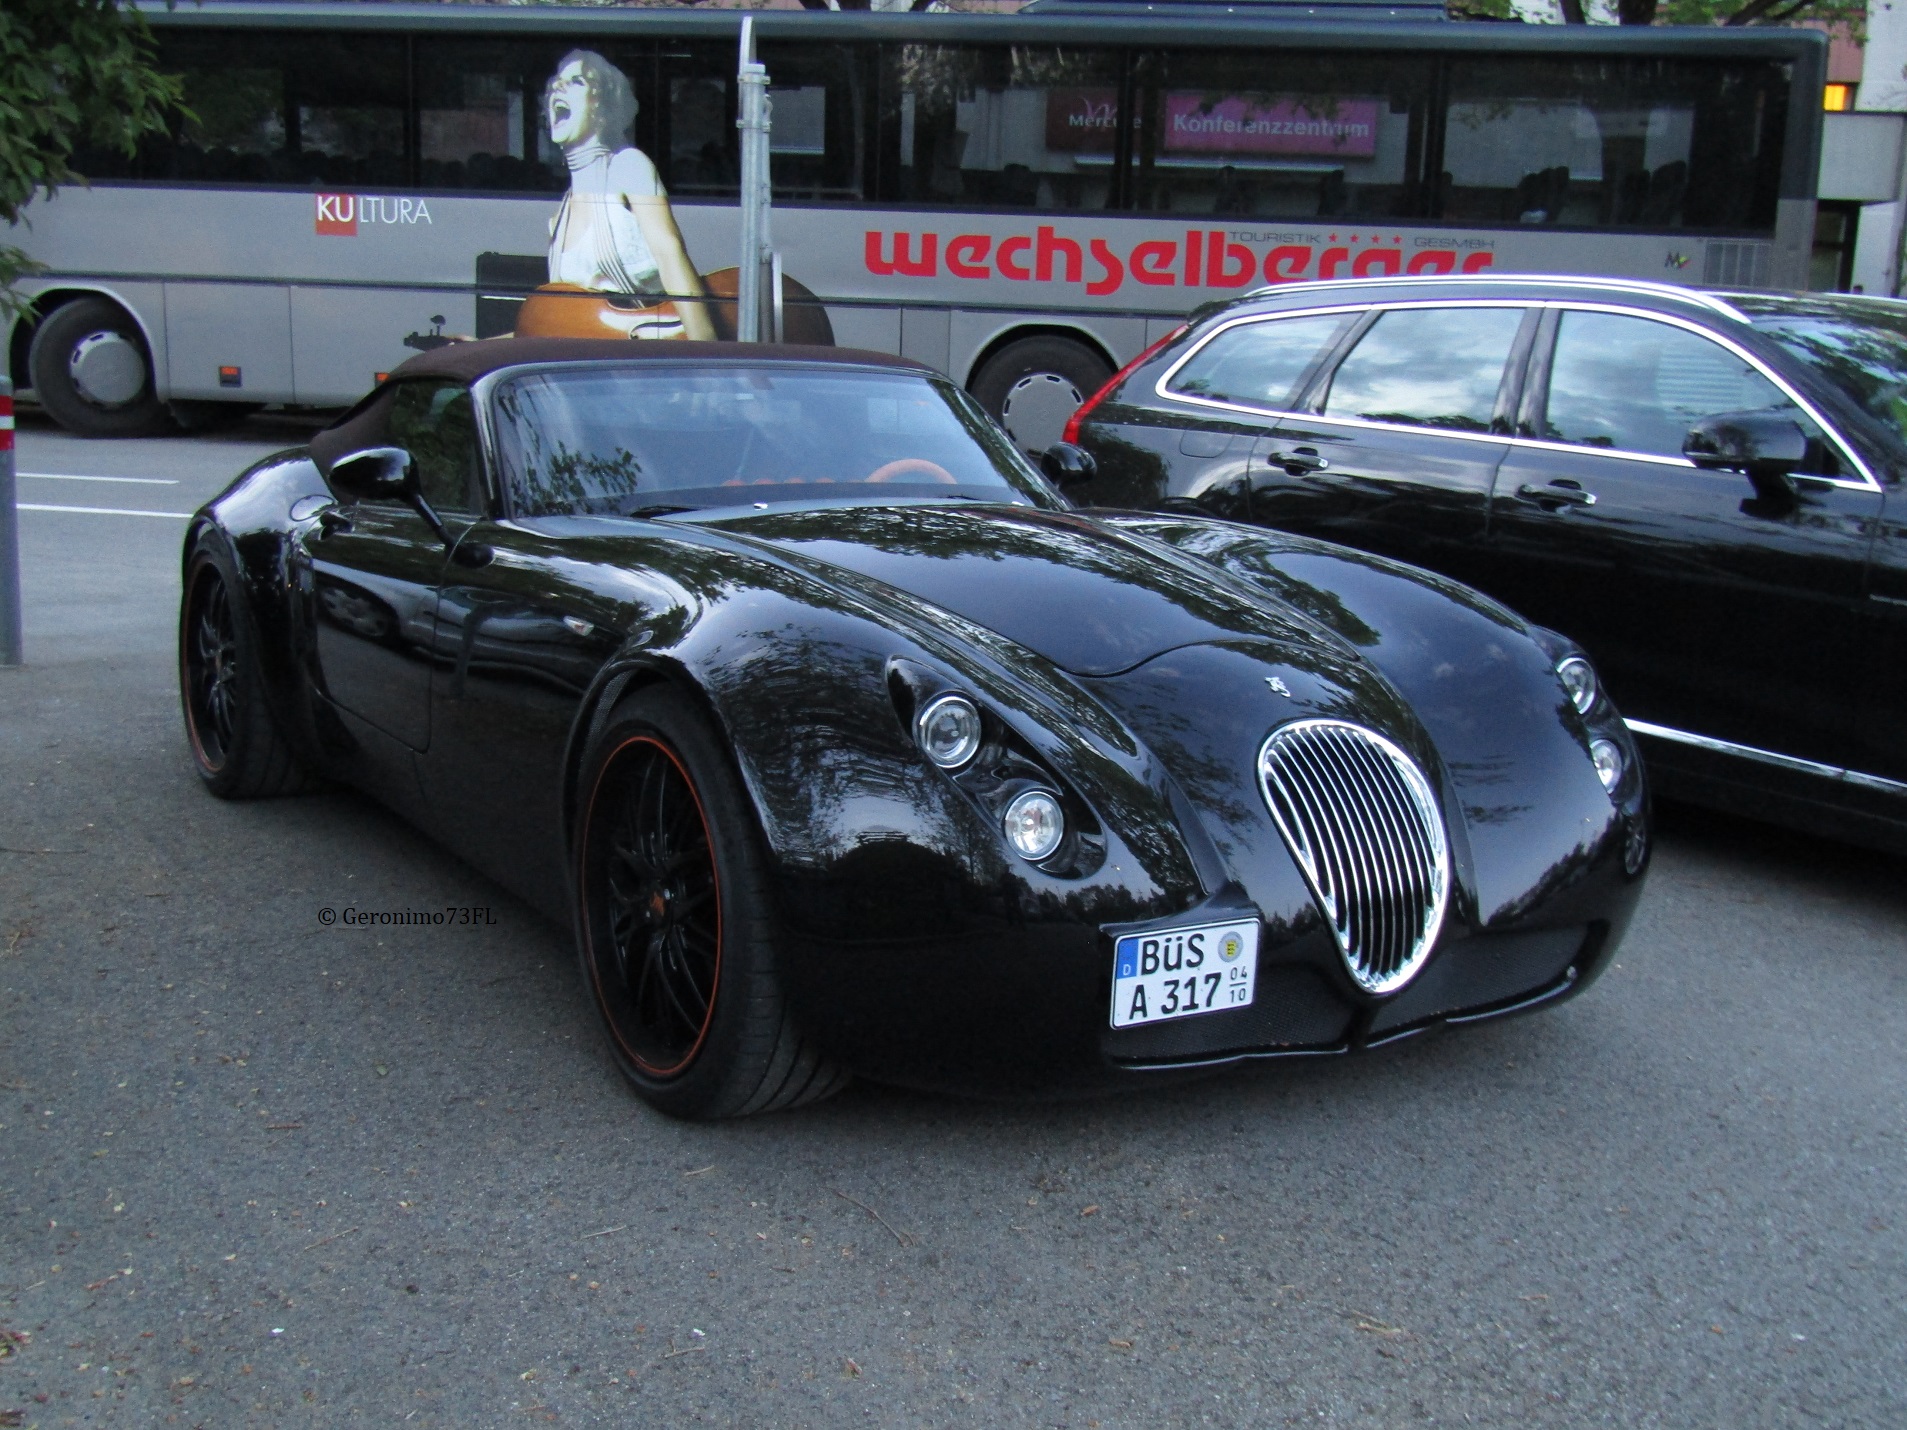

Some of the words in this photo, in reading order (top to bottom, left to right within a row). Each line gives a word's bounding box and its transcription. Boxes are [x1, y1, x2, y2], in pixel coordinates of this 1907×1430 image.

[1069, 114, 1143, 129] Merce
[1173, 113, 1369, 137] Konferenzzentrum
[317, 196, 432, 224] KULTURA
[1230, 231, 1321, 244] TOURISTIK
[1122, 963, 1131, 976] D
[1230, 966, 1248, 981] 04
[1128, 984, 1148, 1020] A
[1161, 972, 1222, 1015] 317
[1229, 988, 1247, 1003] 10
